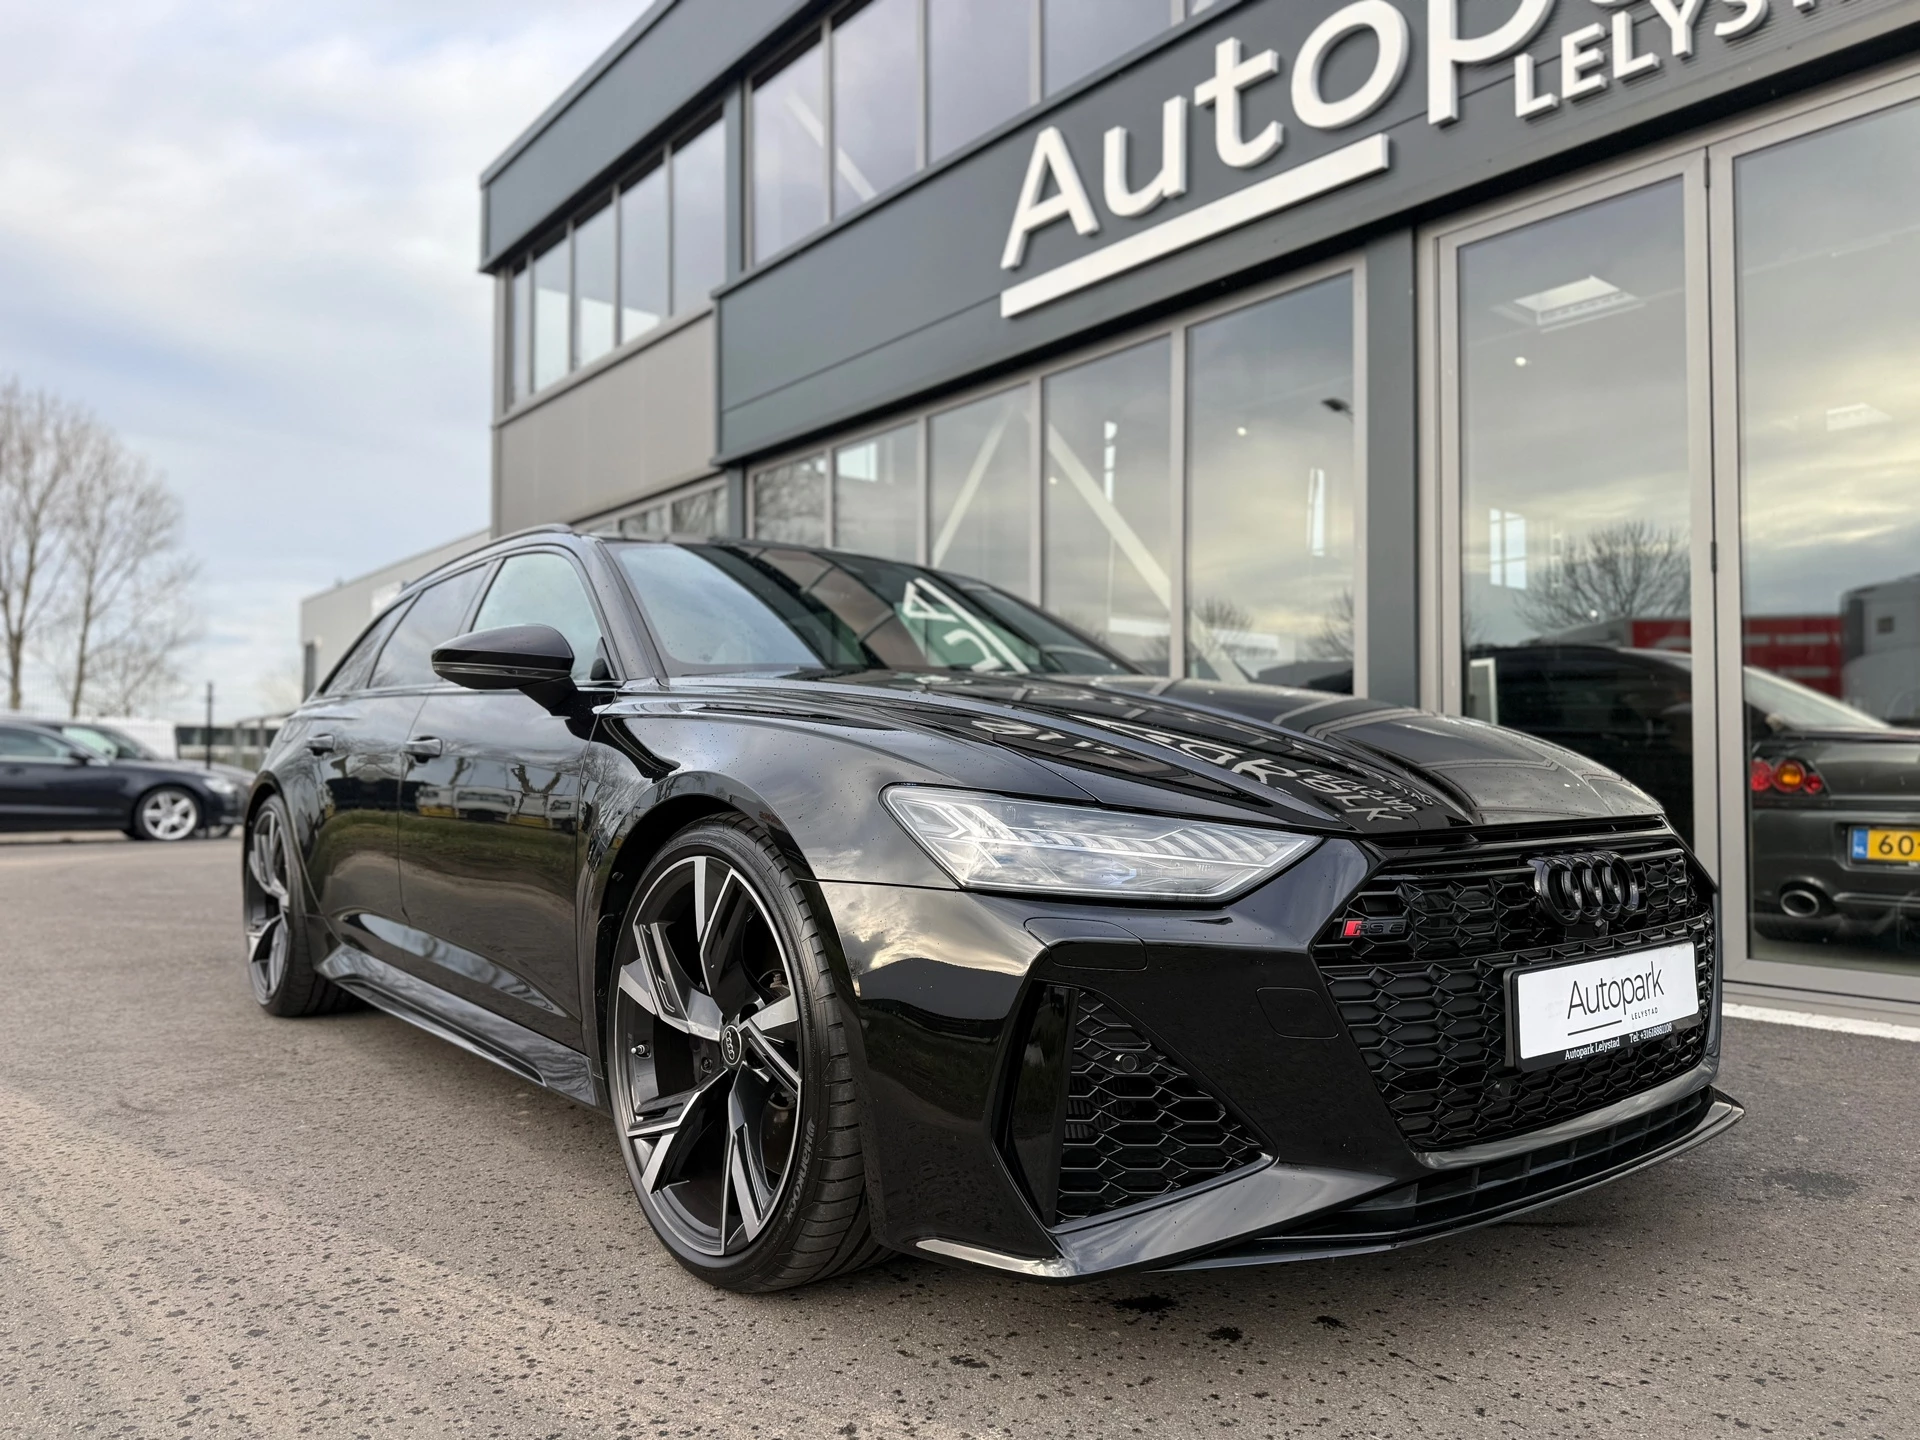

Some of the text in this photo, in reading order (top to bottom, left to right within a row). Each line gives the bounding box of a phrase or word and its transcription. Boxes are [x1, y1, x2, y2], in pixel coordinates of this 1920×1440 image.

[1000, 0, 1646, 269] Autop
[1878, 835, 1920, 856] 60
[1567, 961, 1665, 1019] Autopark
[1631, 1007, 1659, 1020] LELYSTAD
[1564, 1043, 1595, 1060] Autopark
[1595, 1037, 1620, 1053] Lelystad
[784, 1134, 815, 1223] Hankook
